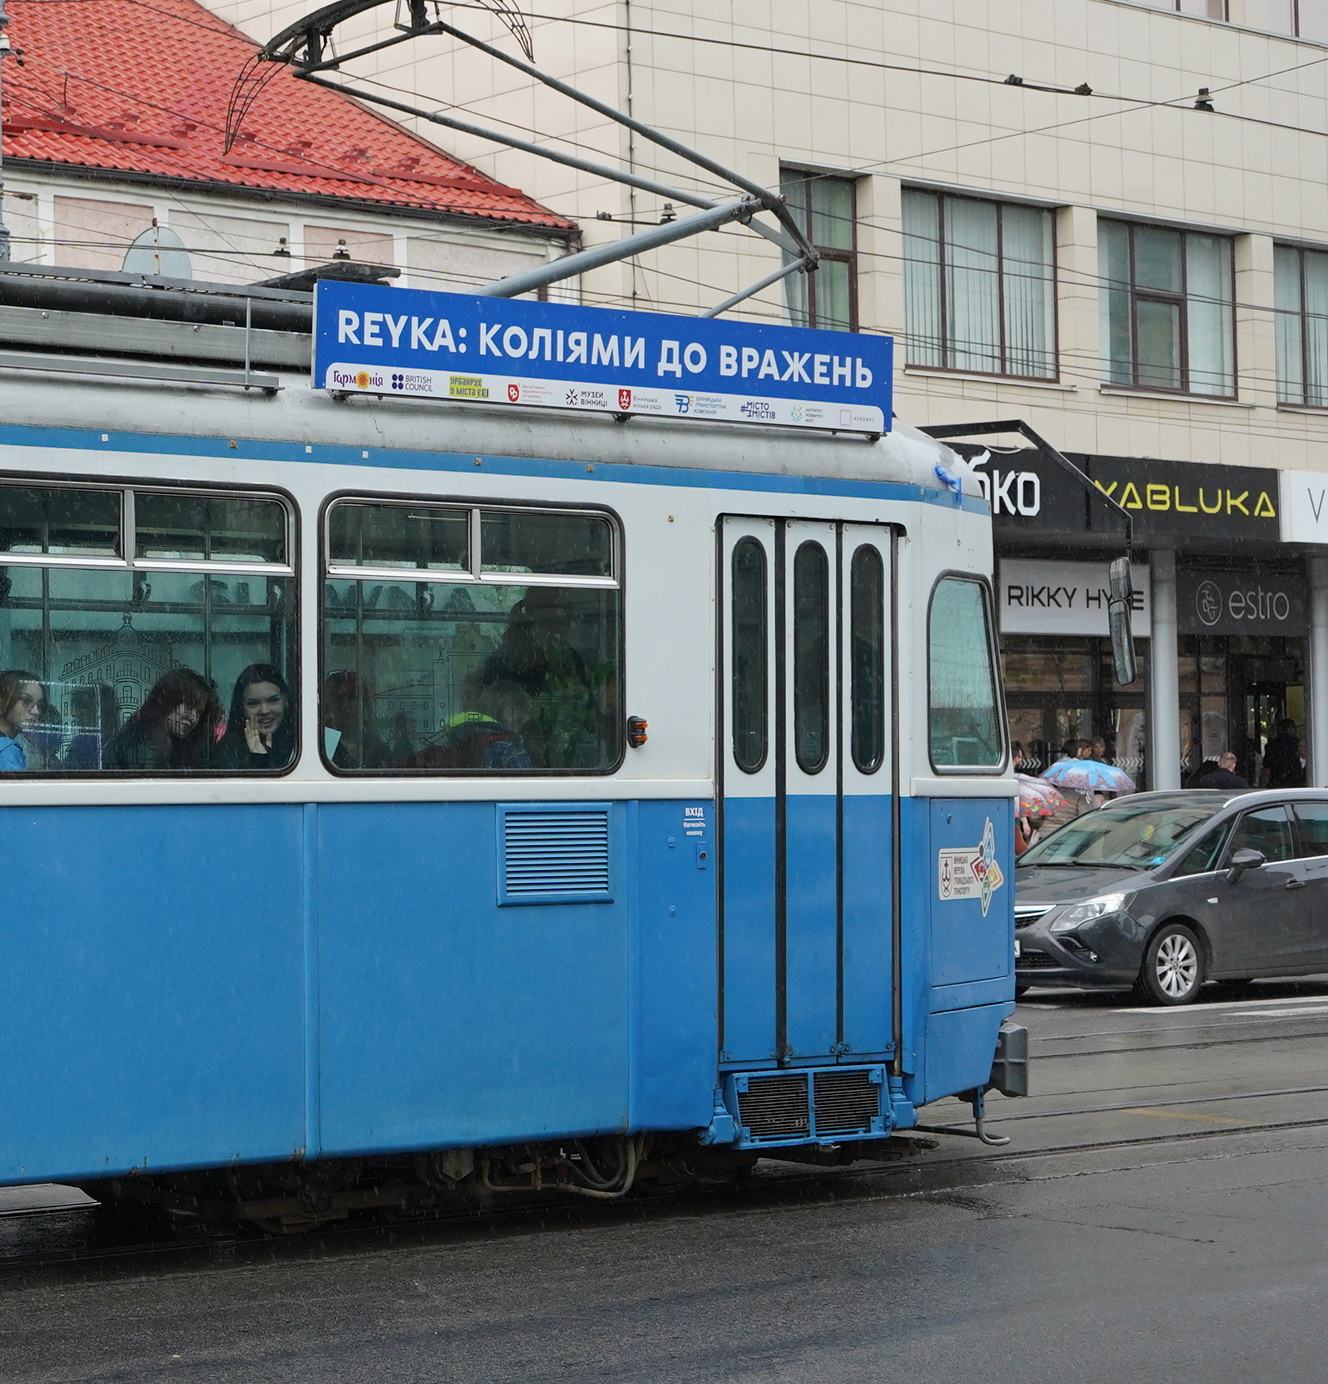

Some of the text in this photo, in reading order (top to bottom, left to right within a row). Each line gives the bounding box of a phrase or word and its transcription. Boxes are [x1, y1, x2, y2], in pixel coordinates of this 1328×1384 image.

[338, 309, 873, 389] REYKA: КОЛІЯМИ ДО ВРАЖЕНЬ
[405, 375, 432, 384] BRITISH
[405, 382, 433, 392] COUNCIL
[1094, 480, 1277, 518] YABLUKA
[1007, 585, 1145, 611] RIKKY HYE
[1228, 585, 1290, 621] estro
[685, 807, 704, 817] ВХІД
